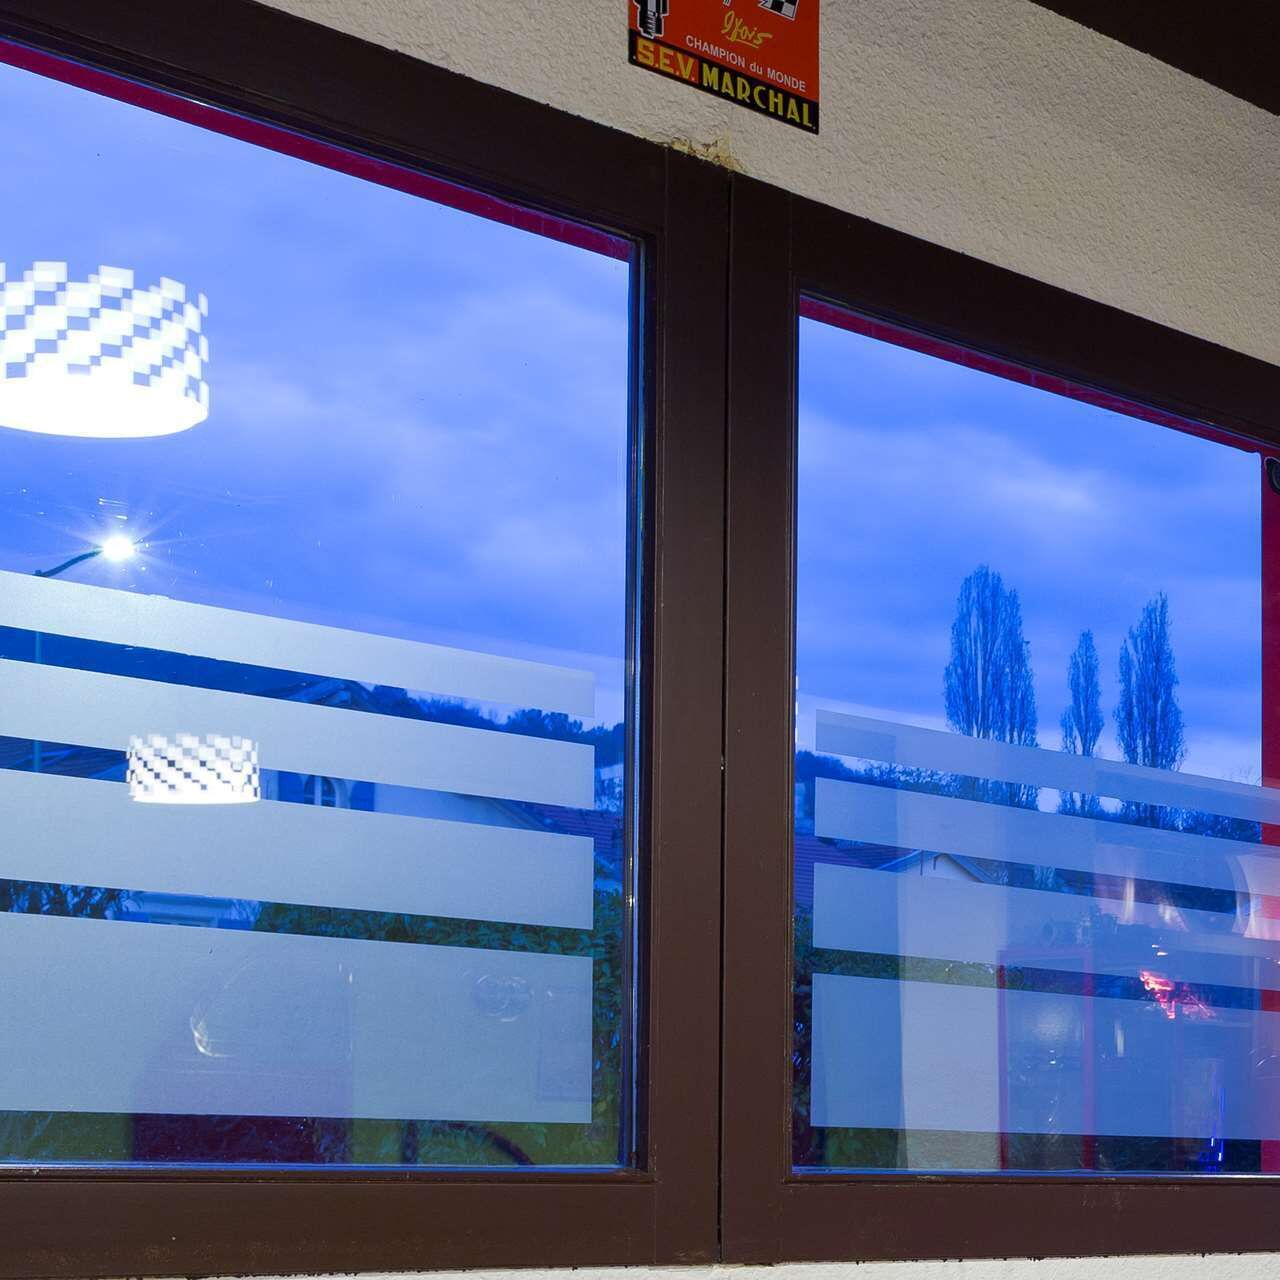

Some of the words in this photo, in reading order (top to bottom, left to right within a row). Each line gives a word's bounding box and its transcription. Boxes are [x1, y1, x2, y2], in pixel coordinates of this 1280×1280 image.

[636, 36, 696, 82] S.E.V.
[702, 62, 813, 128] MARCHAL
[685, 35, 746, 69] CHAMPION
[750, 62, 763, 75] du
[767, 67, 807, 92] MONDE
